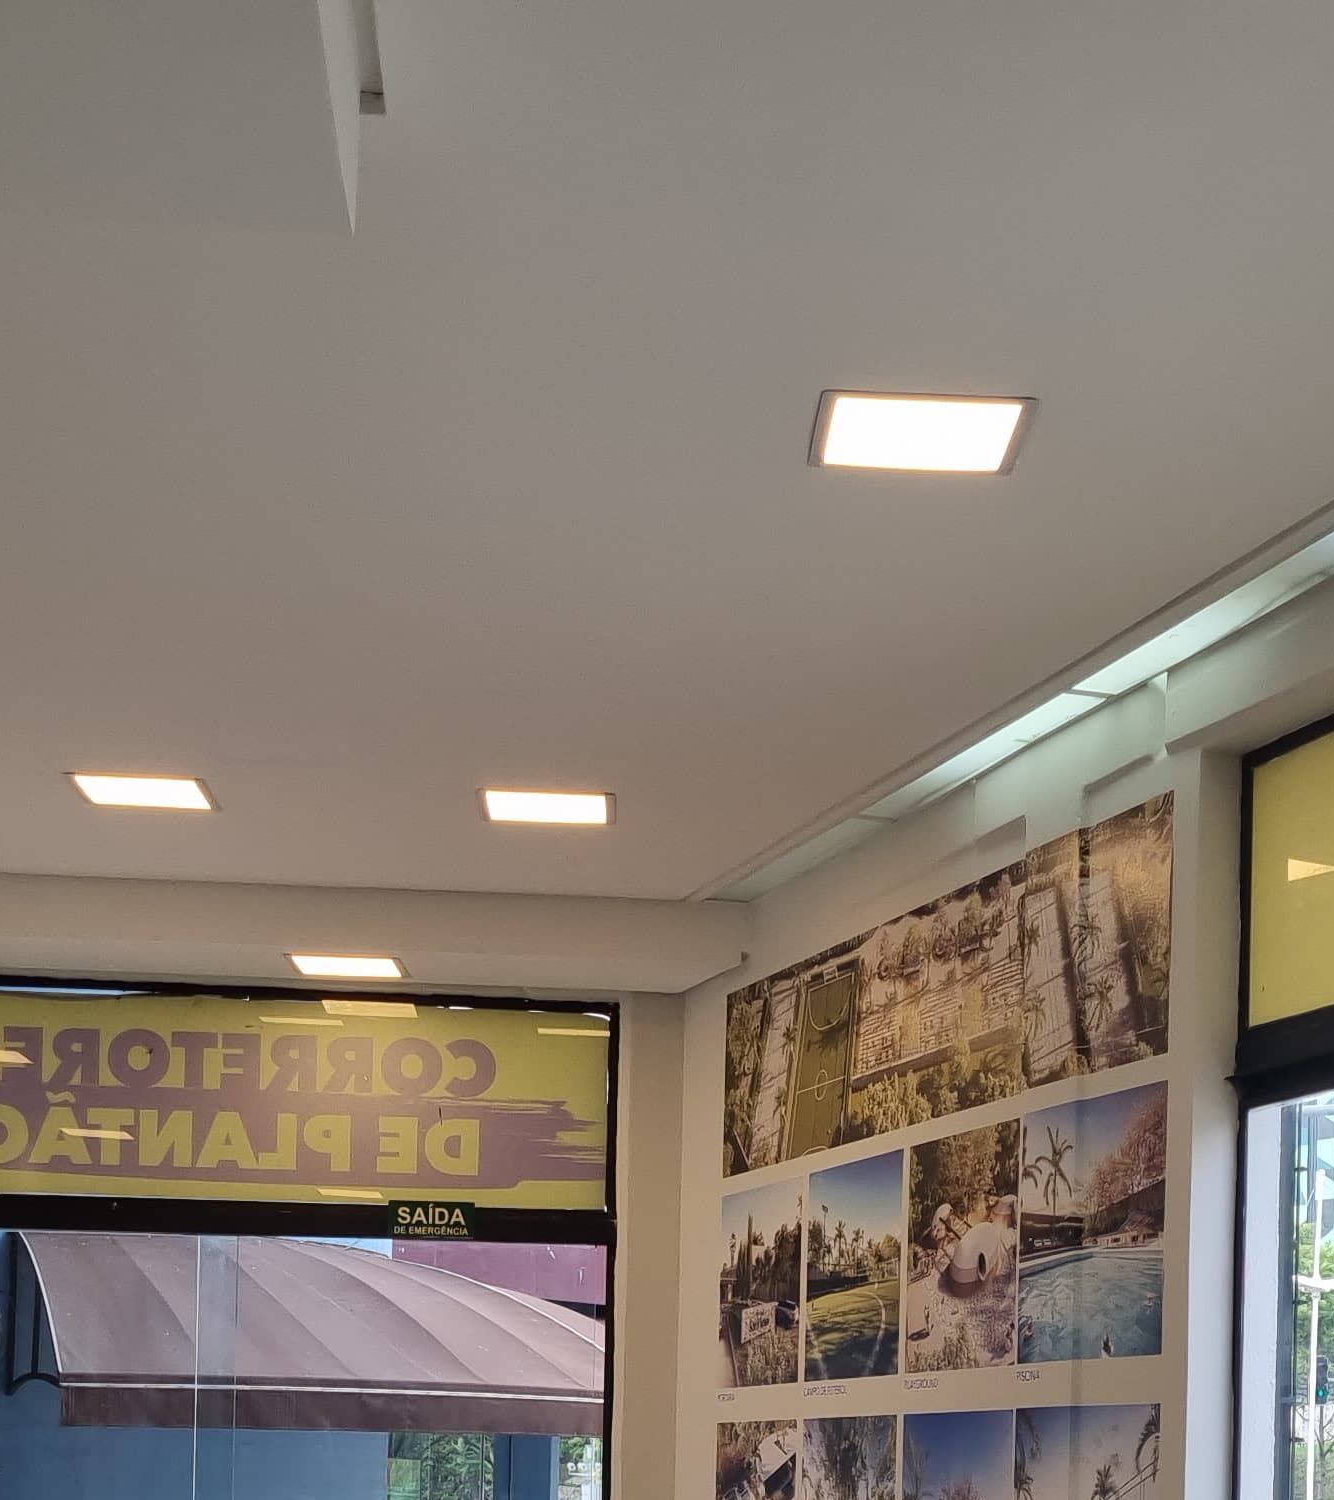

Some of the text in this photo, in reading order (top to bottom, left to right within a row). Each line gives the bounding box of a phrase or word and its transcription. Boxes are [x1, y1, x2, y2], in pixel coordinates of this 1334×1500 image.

[397, 1203, 465, 1225] SAÍDA
[393, 1225, 468, 1236] DE EMERGÊNCIA
